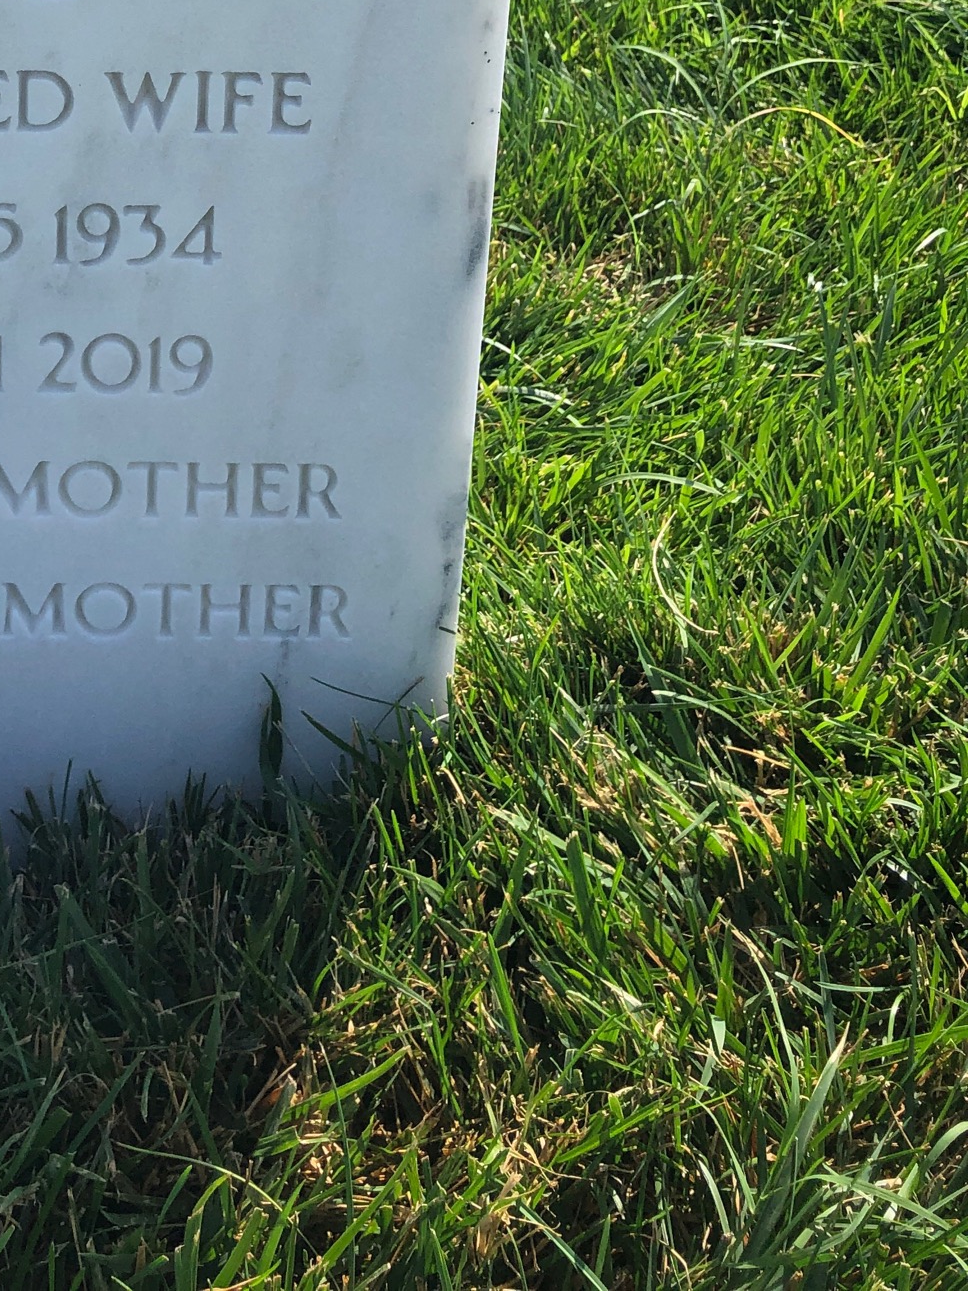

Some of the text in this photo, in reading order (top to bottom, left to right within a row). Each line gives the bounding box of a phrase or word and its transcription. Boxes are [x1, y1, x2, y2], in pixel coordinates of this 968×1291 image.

[104, 71, 312, 135] WIFE
[52, 203, 223, 267] 1934
[36, 332, 214, 395] 2019
